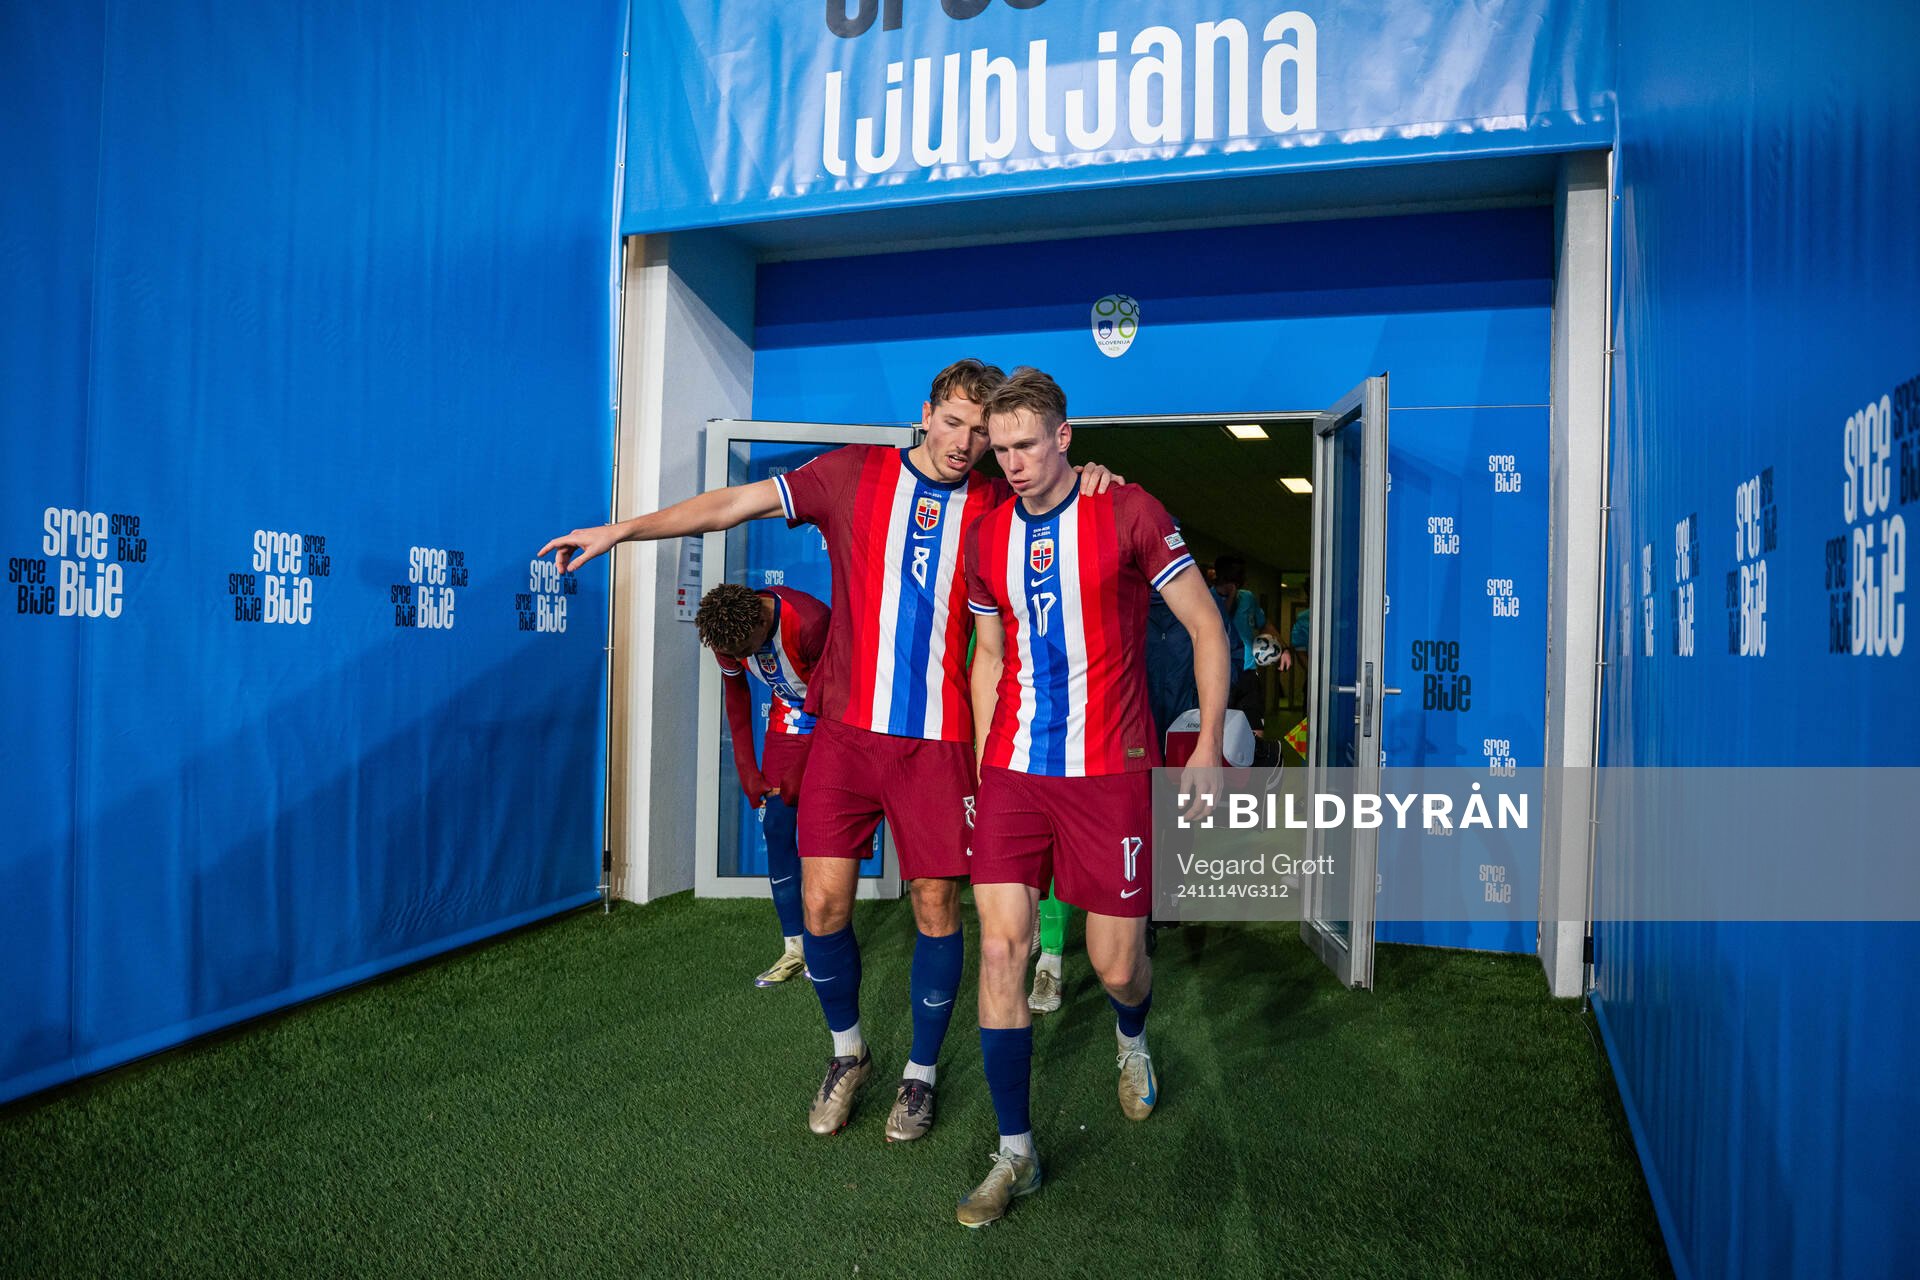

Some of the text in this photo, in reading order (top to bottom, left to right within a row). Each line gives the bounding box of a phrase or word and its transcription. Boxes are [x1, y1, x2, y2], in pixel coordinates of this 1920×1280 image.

[58, 560, 123, 618] Bije
[911, 546, 930, 589] 8
[17, 585, 55, 615] Bije
[264, 574, 312, 625] Bije
[417, 585, 455, 630] Bije
[1031, 592, 1057, 637] 17
[1423, 673, 1471, 713] Bije
[1121, 837, 1144, 882] 17
